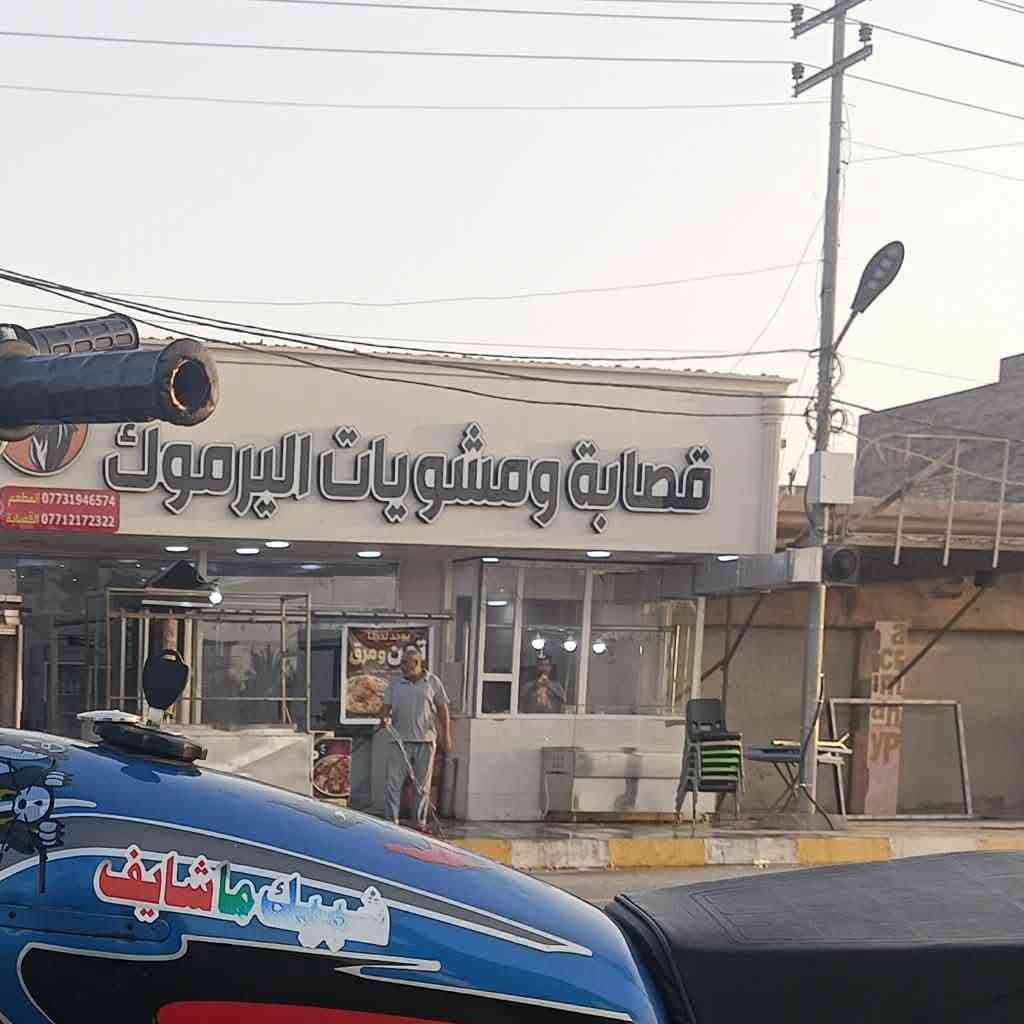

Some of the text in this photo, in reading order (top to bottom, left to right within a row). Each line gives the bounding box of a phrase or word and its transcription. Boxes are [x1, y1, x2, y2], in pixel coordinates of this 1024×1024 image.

[41, 492, 116, 507] 07731946574
[103, 419, 713, 534] قصابة ومشويات اليرموك
[41, 513, 116, 528] 07712172322
[94, 845, 215, 922] شايف
[217, 860, 258, 926] ما
